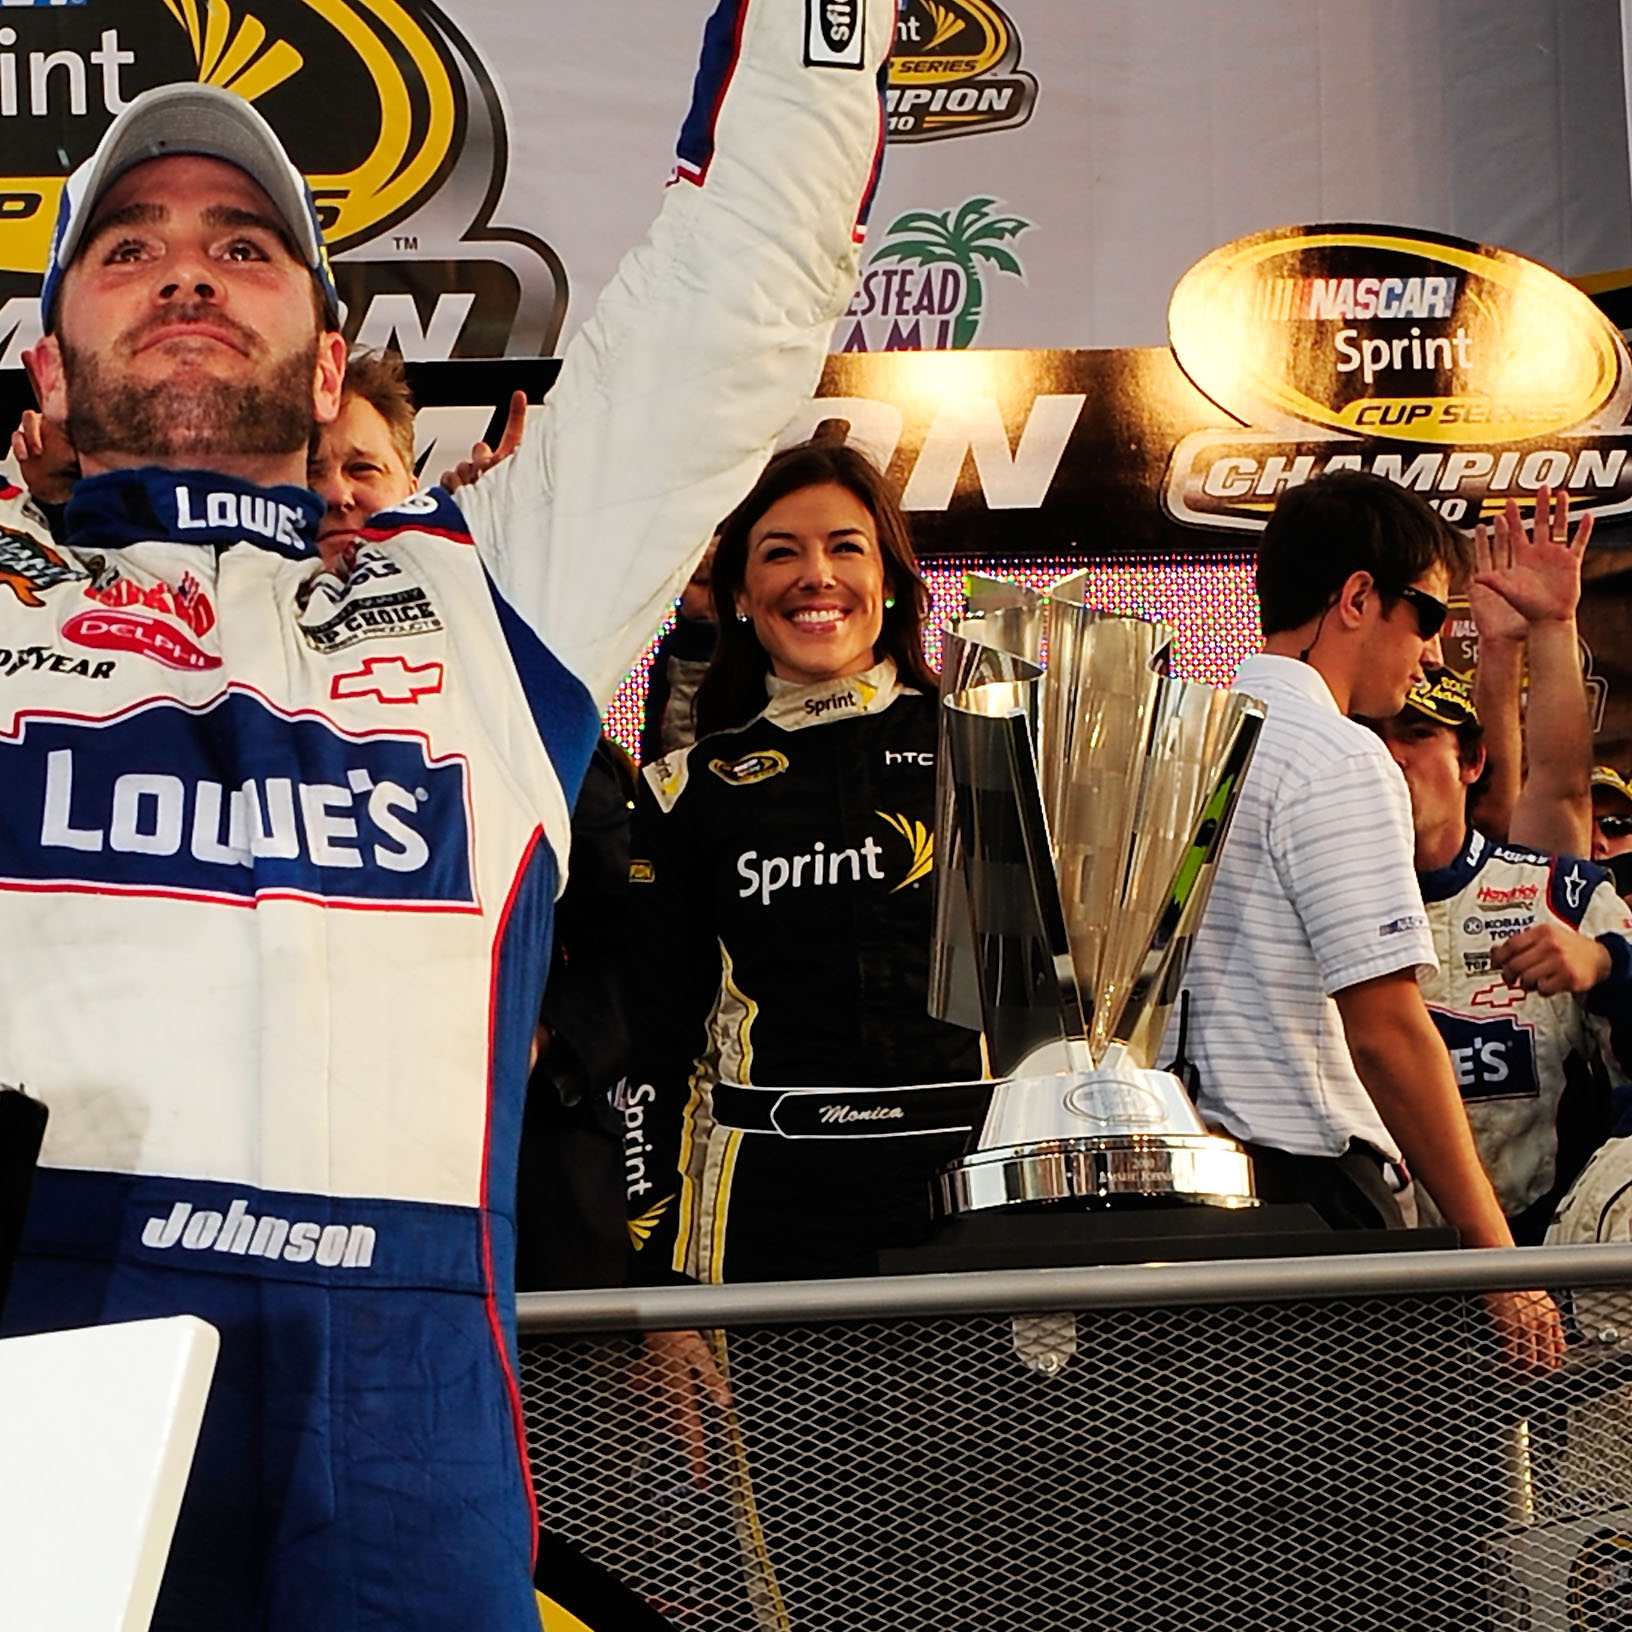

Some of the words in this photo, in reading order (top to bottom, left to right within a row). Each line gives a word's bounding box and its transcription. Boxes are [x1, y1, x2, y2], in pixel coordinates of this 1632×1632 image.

[898, 58, 977, 74] SERIES
[1308, 277, 1452, 319] NASCAR
[1333, 327, 1473, 383] Sprint
[1354, 404, 1434, 426] CUP
[343, 601, 437, 632] CHOICE
[79, 620, 205, 667] DELPHI
[804, 690, 857, 718] Sprint
[40, 749, 430, 873] LOWE'S
[736, 835, 886, 905] Sprint
[818, 1104, 905, 1124] Monica
[623, 1083, 656, 1201] Sprint
[141, 1199, 377, 1269] Johnson
